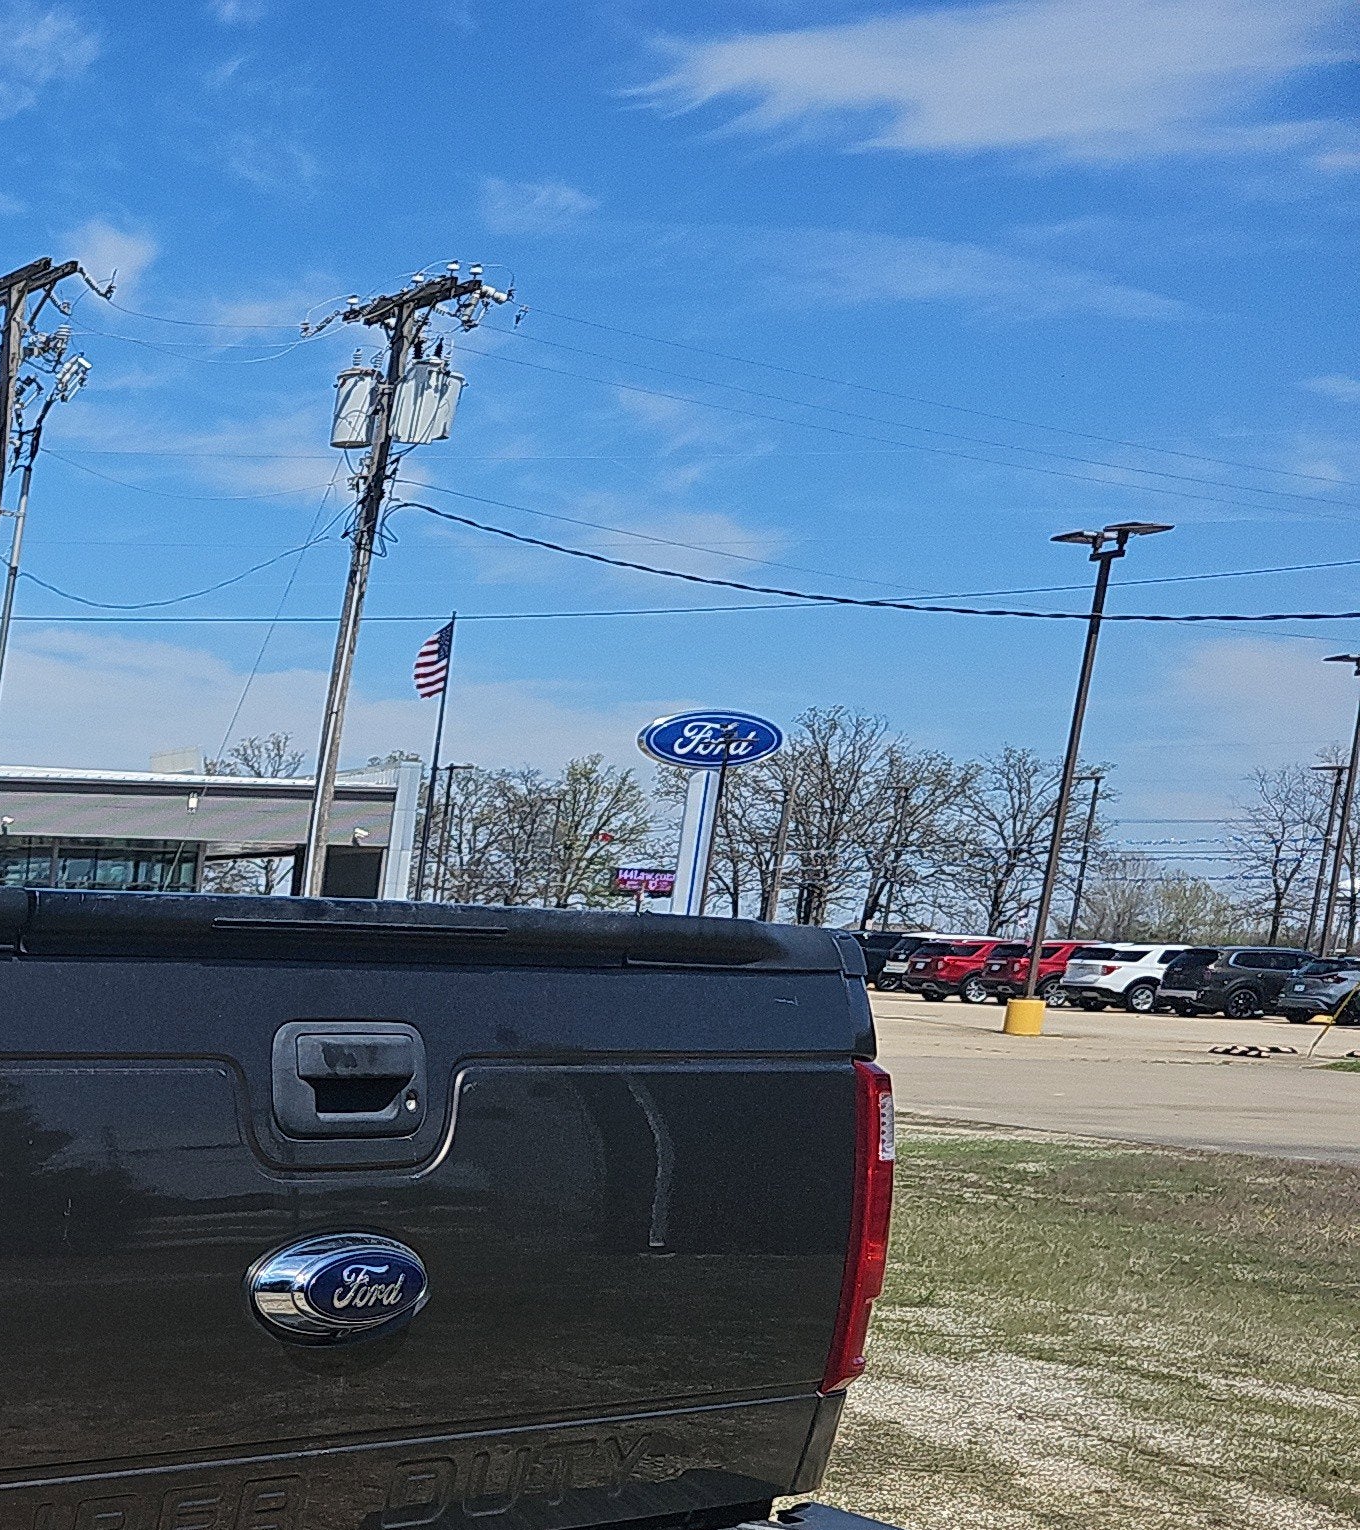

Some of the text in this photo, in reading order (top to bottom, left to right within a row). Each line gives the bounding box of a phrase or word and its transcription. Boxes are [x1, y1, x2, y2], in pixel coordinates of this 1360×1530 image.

[673, 721, 757, 756] Ford
[332, 1264, 406, 1309] Ford
[379, 1433, 654, 1530] DUTY
